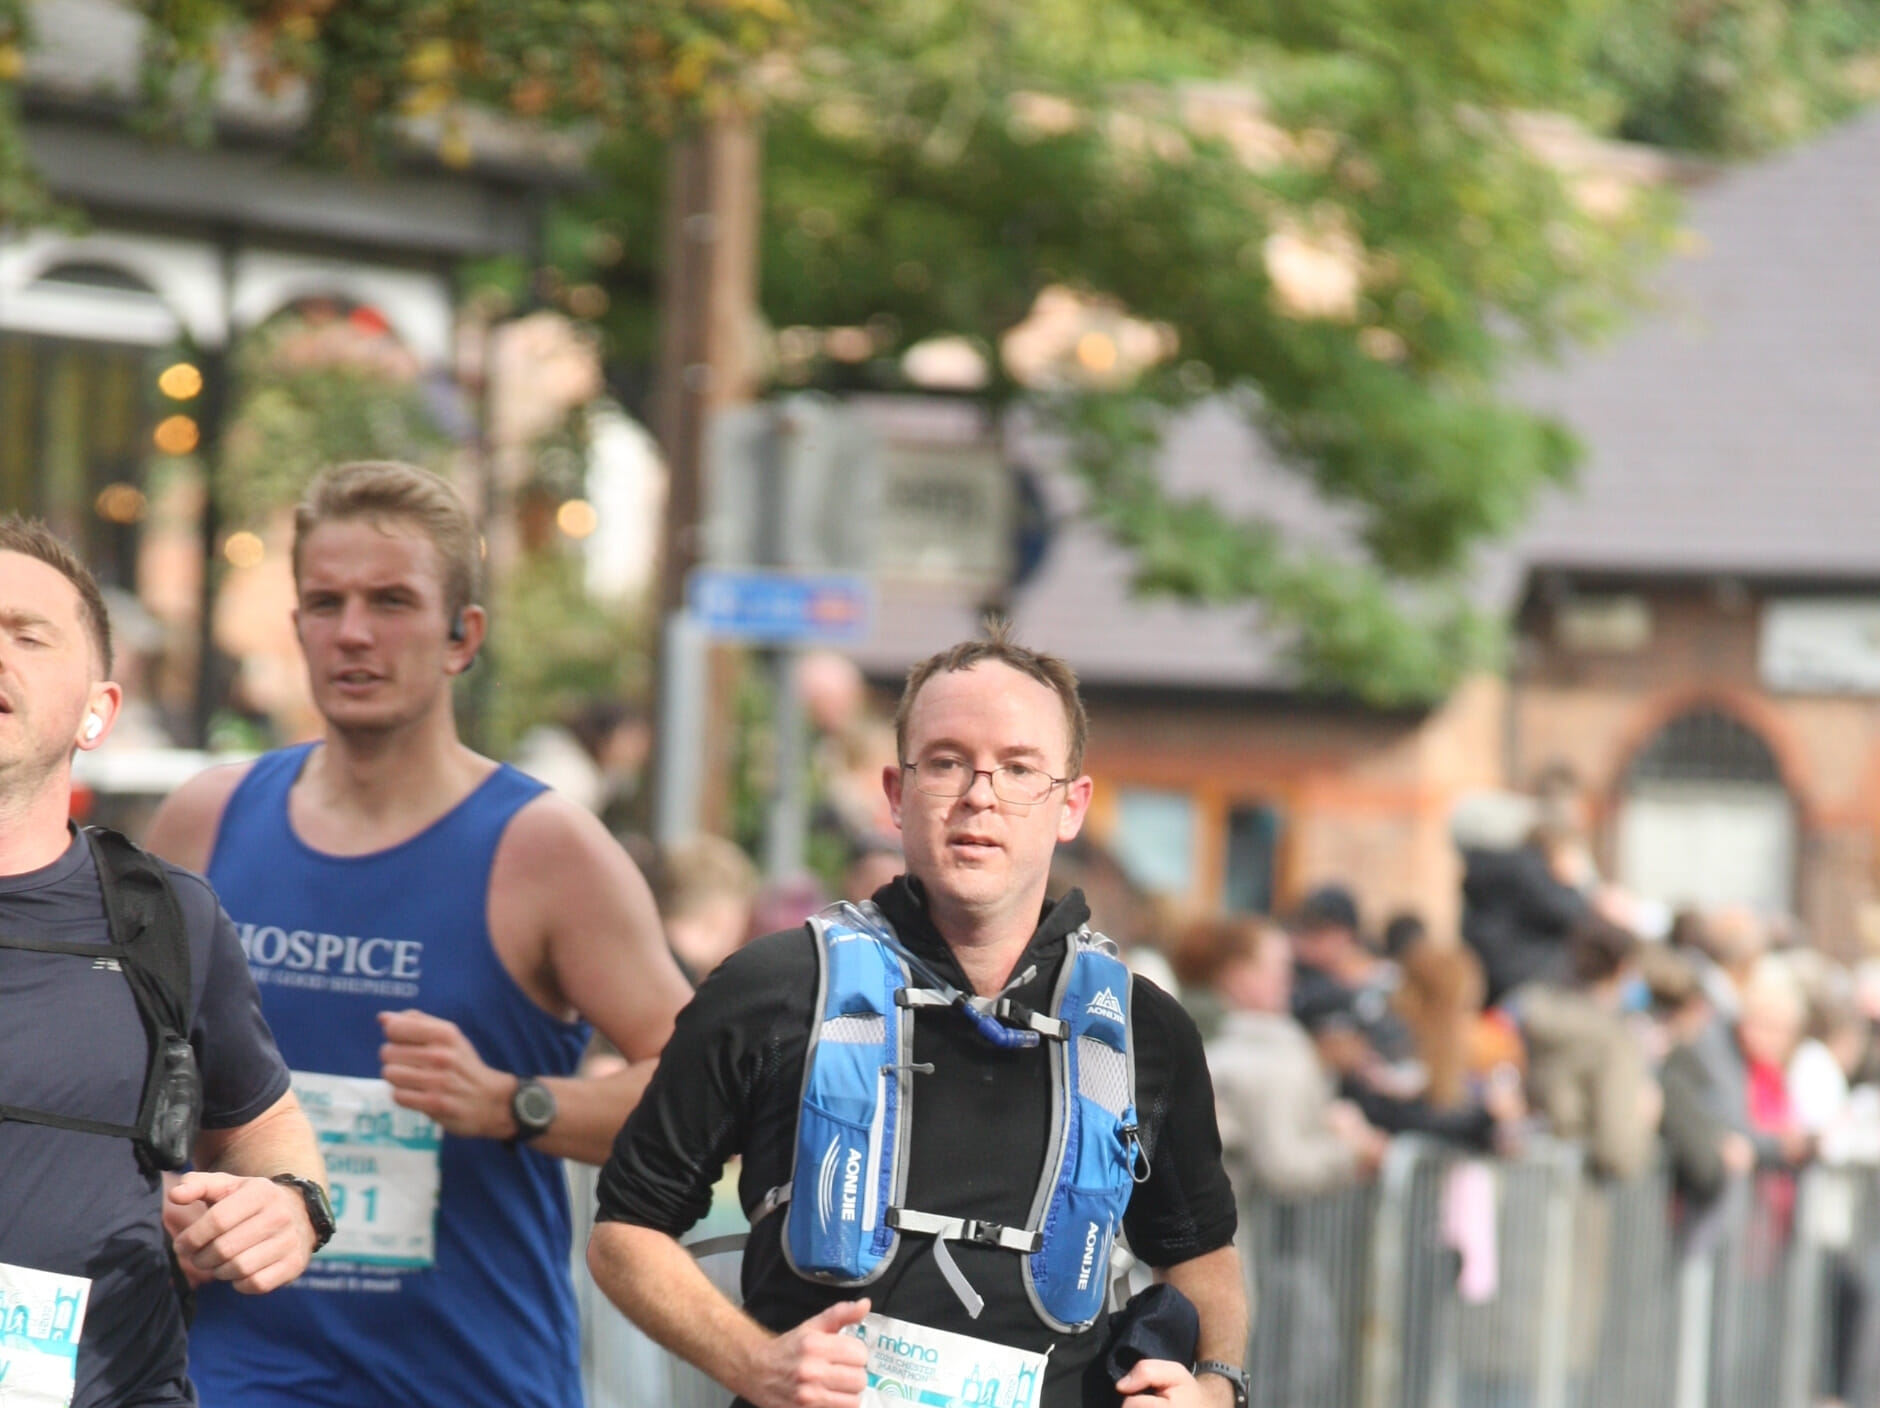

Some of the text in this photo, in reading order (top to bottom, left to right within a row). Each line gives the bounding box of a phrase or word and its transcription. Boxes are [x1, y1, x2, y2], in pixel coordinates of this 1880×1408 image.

[232, 921, 424, 980] HOSPICE
[325, 1155, 379, 1175] SHUA
[841, 1147, 862, 1221] AONIJIE
[328, 1183, 380, 1224] 91
[1077, 1221, 1099, 1290] AONIJIE
[877, 1333, 939, 1364] mbna
